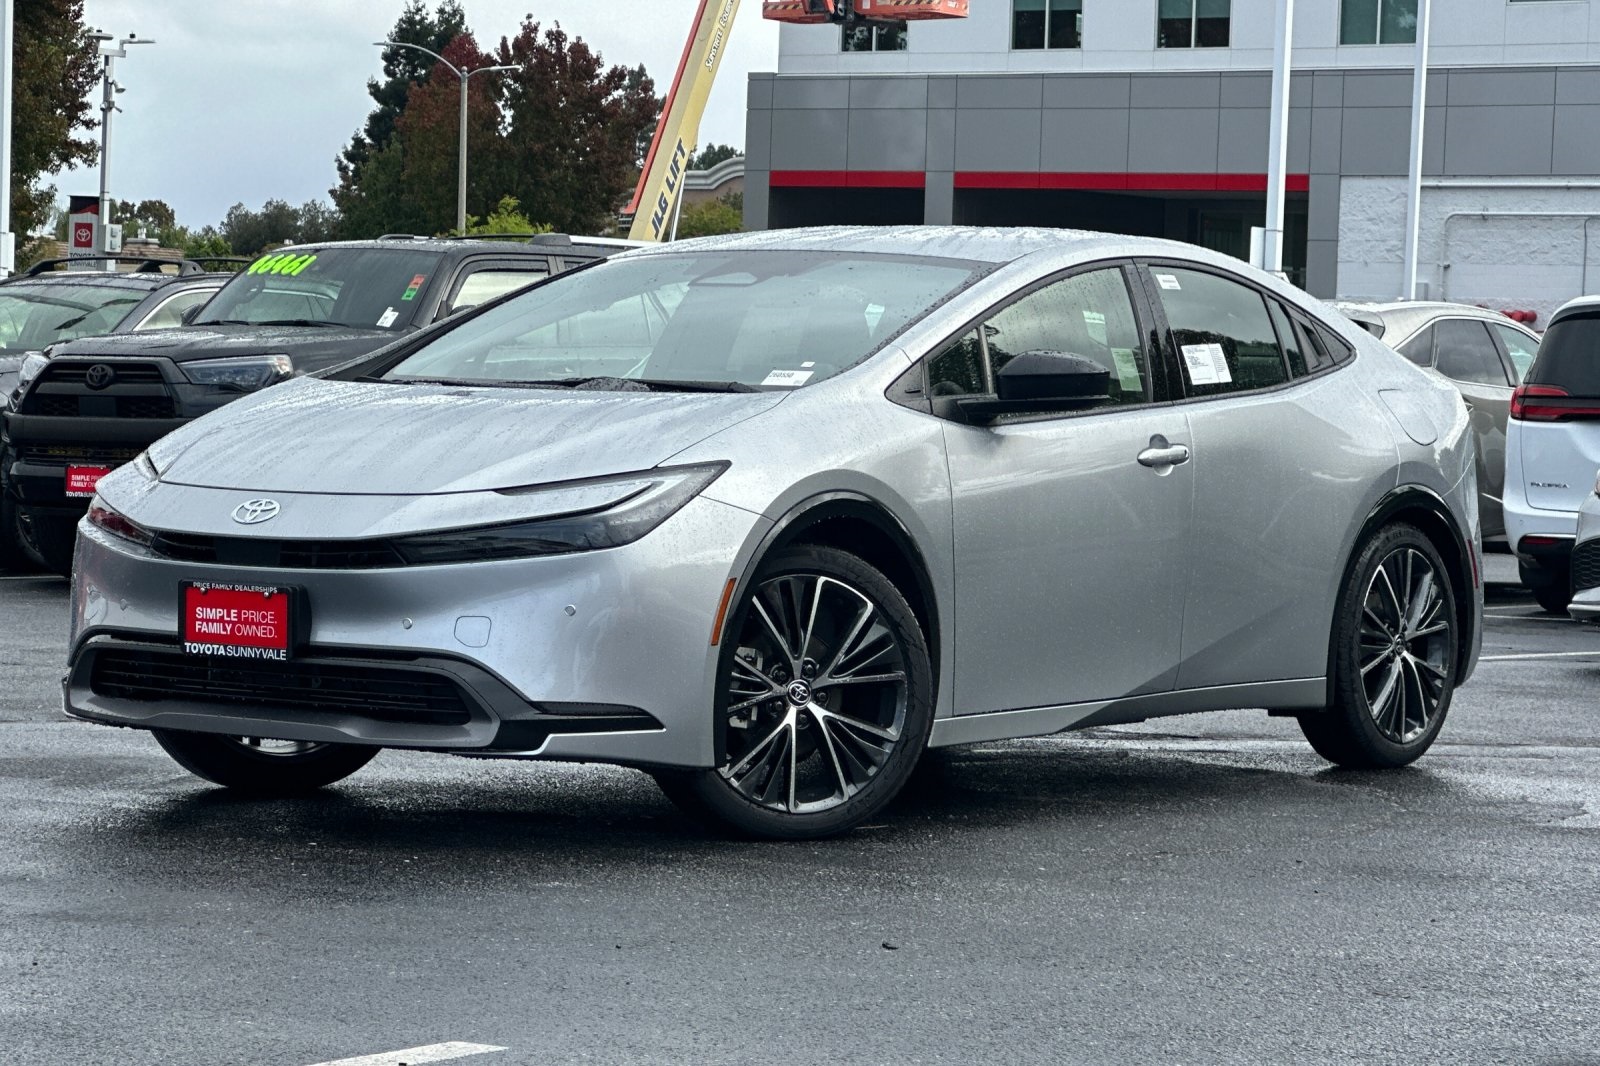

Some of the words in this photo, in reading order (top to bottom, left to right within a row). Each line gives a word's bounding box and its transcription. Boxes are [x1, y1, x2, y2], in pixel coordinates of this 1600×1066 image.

[652, 190, 669, 240] JLG
[666, 137, 686, 194] LIFT
[193, 581, 211, 589] PRICE
[212, 583, 233, 591] FAMILY
[234, 585, 278, 593] DEALERSHIPS
[195, 607, 238, 621] SIMPLE
[241, 610, 278, 624] PRICE.
[195, 621, 232, 635] FAMILY
[234, 624, 278, 638] OWNED.
[184, 642, 226, 655] TOYOTA
[226, 645, 287, 661] SUNNYVALE
